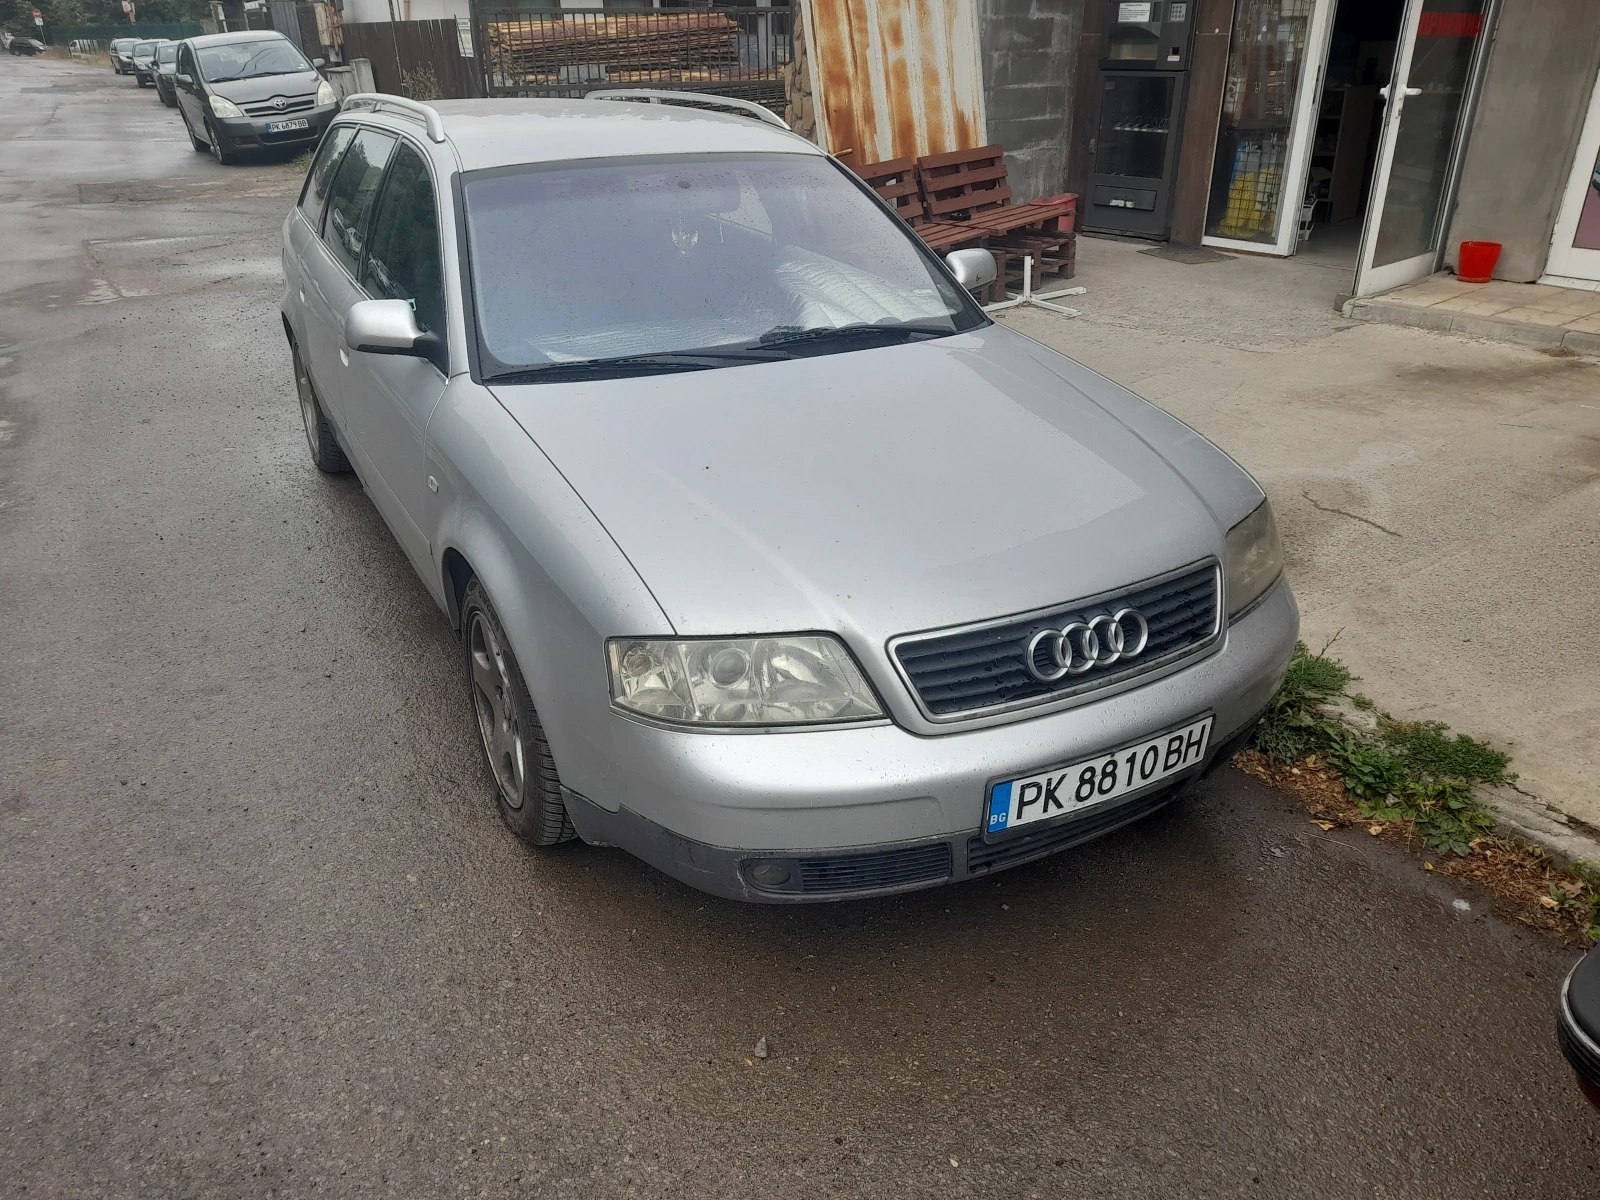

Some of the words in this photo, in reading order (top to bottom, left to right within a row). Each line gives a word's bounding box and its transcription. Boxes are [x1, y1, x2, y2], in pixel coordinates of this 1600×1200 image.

[1016, 772, 1067, 820] PK
[1074, 744, 1159, 803] 8810
[1162, 724, 1207, 772] BH
[989, 812, 1007, 825] BG
